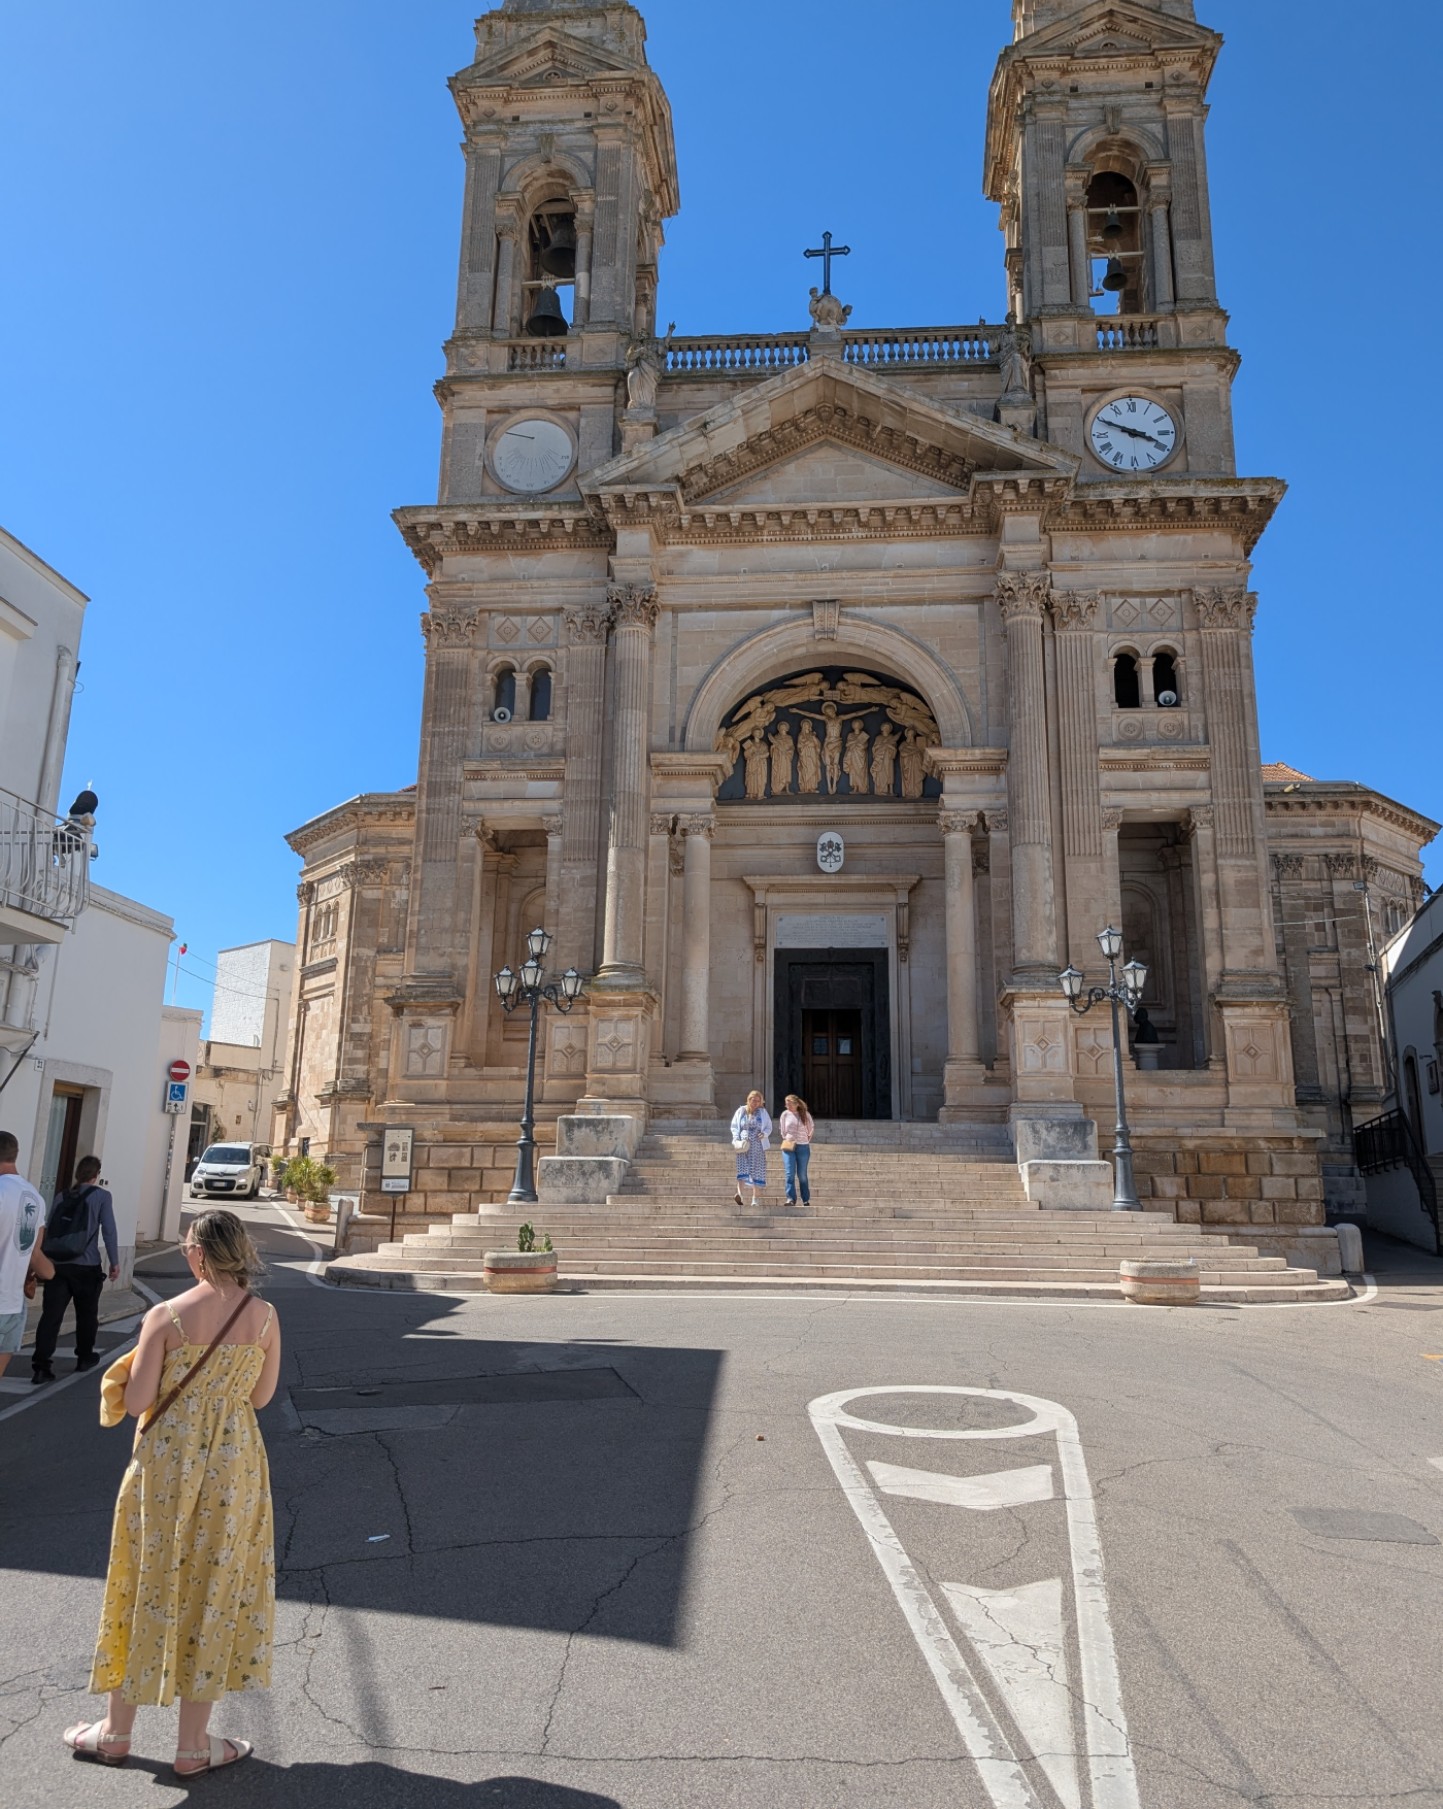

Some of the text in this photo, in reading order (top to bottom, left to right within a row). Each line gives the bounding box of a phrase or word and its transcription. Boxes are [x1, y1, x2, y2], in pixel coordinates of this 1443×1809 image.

[1110, 405, 1122, 417] XI
[1126, 402, 1136, 413] XII
[1144, 404, 1151, 415] I
[1096, 431, 1108, 439] IX
[1130, 456, 1139, 467] VI
[1146, 452, 1156, 463] V
